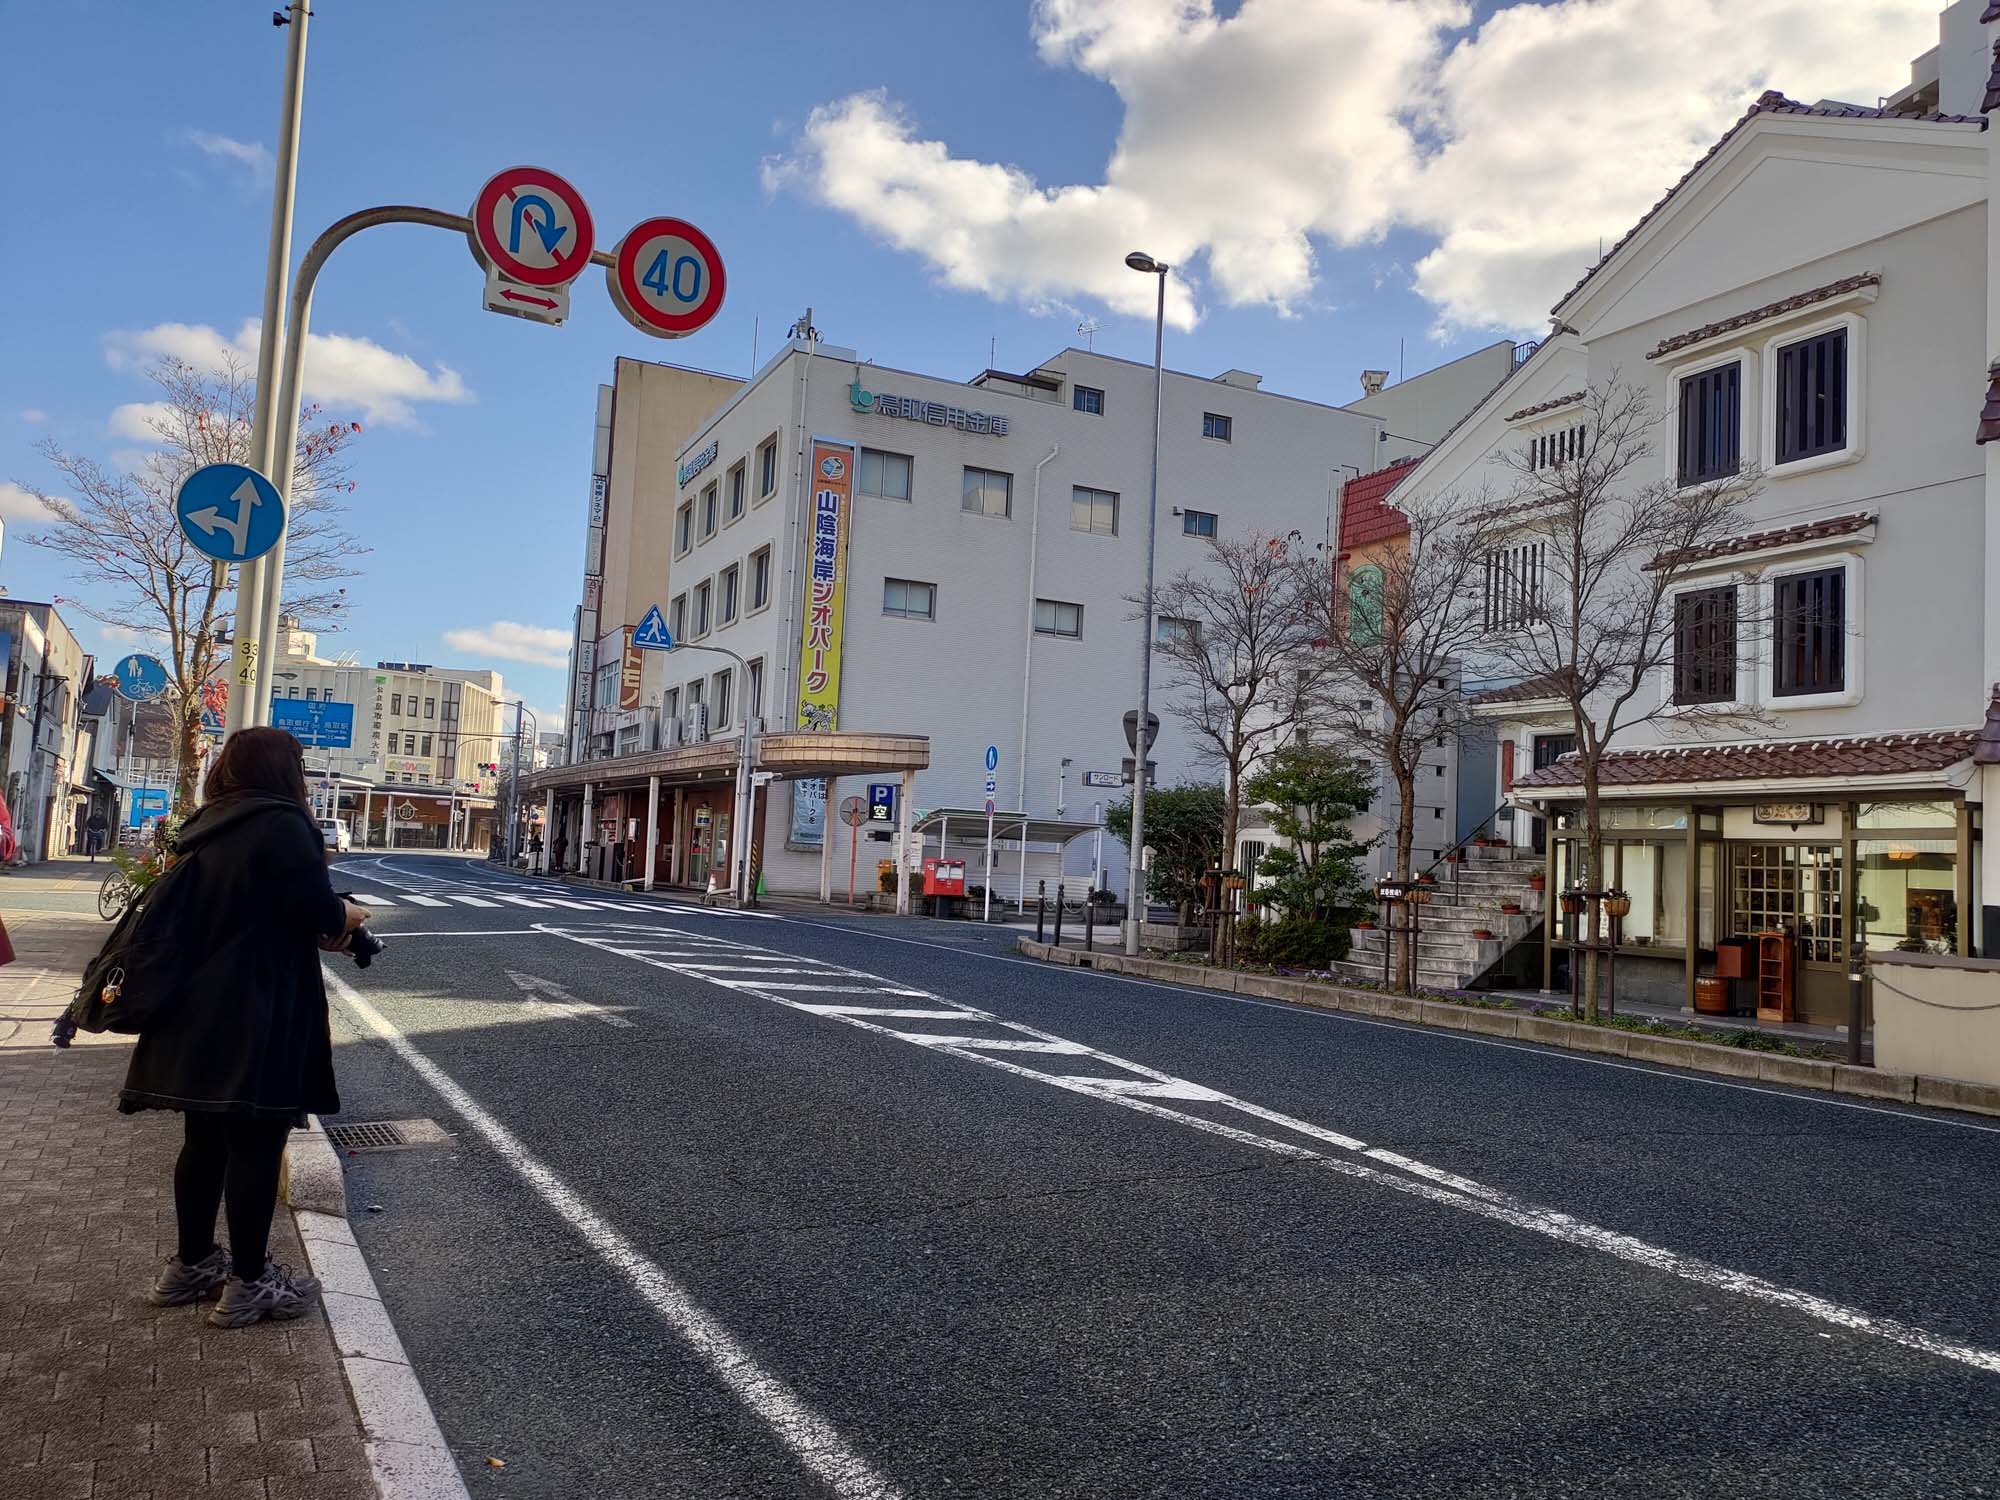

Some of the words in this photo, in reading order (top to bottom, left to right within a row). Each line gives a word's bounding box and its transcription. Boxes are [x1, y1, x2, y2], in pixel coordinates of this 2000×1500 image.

[642, 249, 702, 302] 40
[876, 393, 1009, 436] 鳥取信用金庫
[807, 488, 839, 694] 山陰海岸ジオパーク
[241, 642, 257, 656] 33
[246, 655, 255, 667] 7
[239, 668, 256, 680] 40
[875, 787, 888, 802] P
[873, 804, 887, 819] 空
